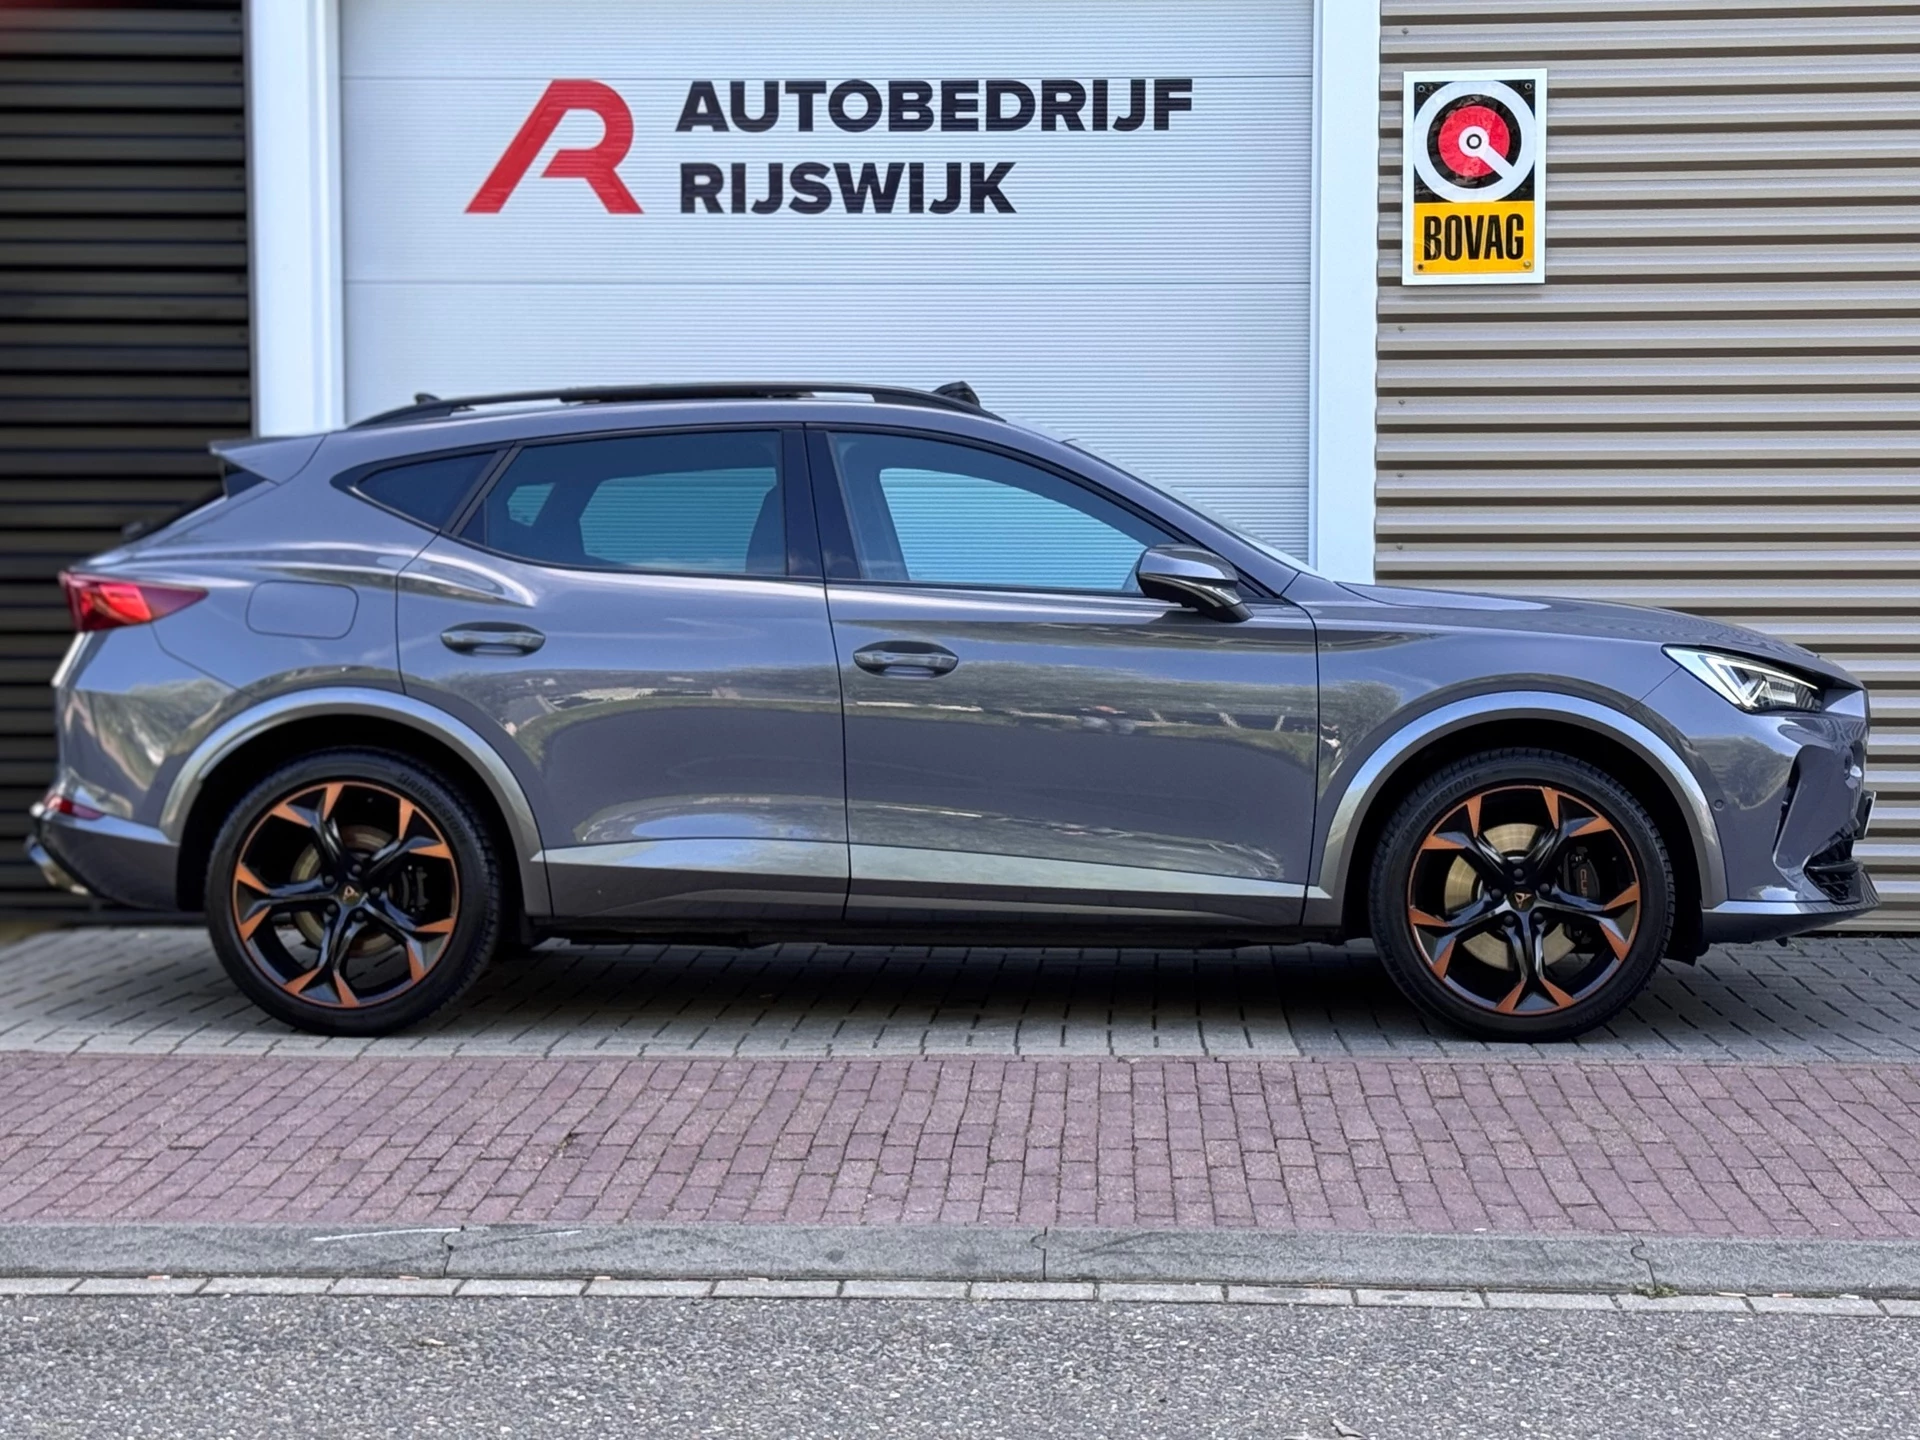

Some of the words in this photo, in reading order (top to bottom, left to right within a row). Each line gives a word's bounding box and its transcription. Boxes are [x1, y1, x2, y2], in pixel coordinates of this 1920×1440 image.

[674, 78, 1193, 132] AUTOBEDRIJF
[679, 162, 1017, 215] RIJSWIJK
[1423, 213, 1525, 262] BOVAG
